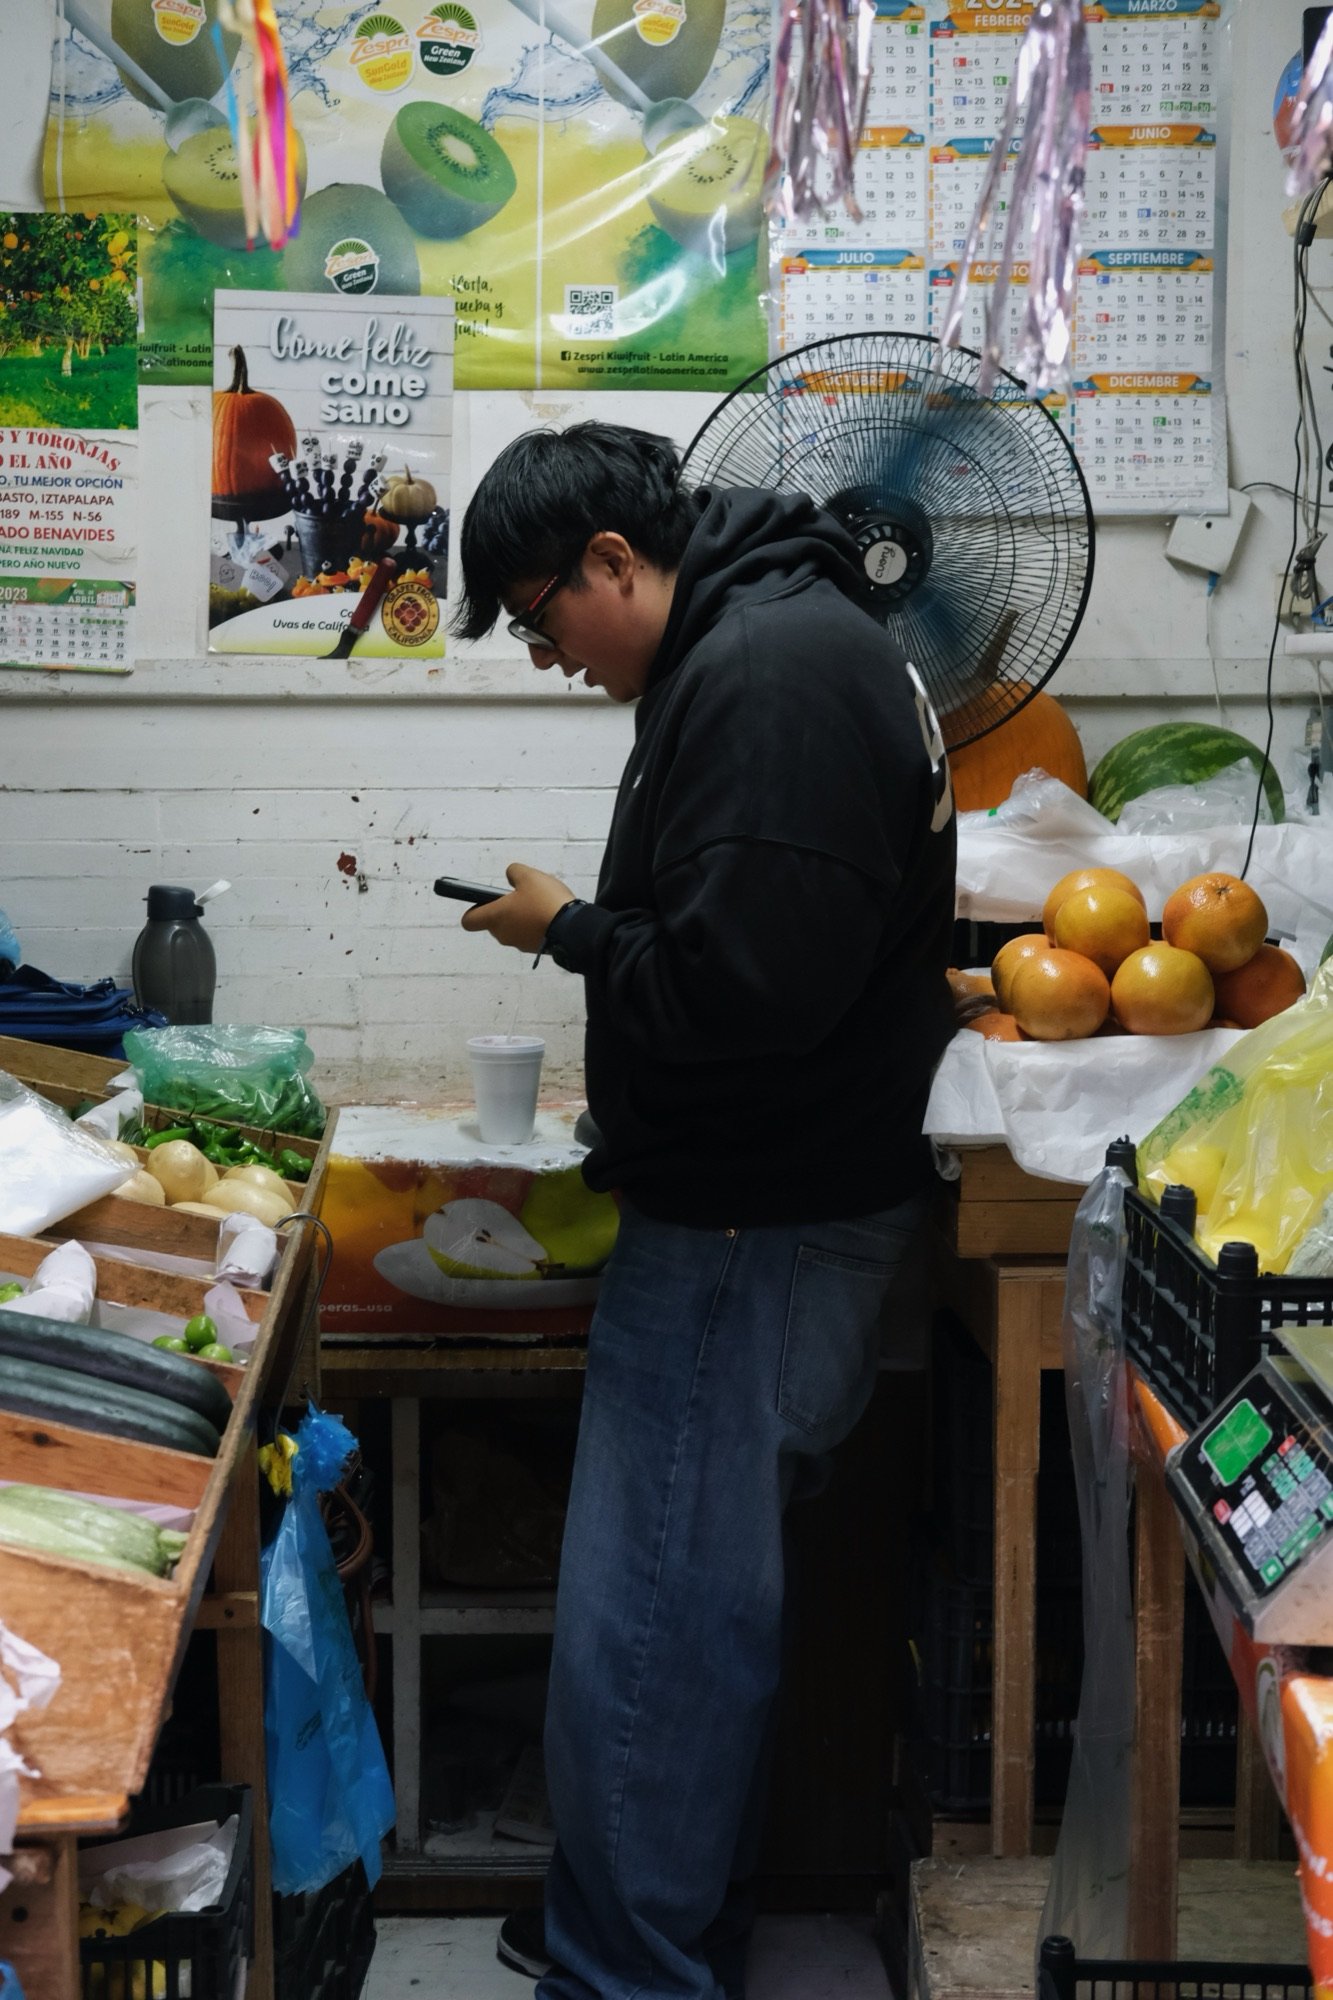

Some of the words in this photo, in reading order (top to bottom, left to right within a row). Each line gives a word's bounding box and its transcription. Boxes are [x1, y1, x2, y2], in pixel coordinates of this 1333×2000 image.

[1128, 0, 1178, 12] MARZO
[974, 15, 1032, 26] FEBRERO
[416, 16, 478, 43] Zespri
[349, 35, 409, 64] Zespri
[431, 45, 461, 57] Green
[886, 46, 894, 54] 12
[906, 46, 914, 54] 13
[424, 55, 439, 63] New
[440, 57, 466, 66] Zealand
[365, 60, 407, 78] SunGold
[906, 66, 916, 74] 20
[885, 86, 896, 94] 26
[906, 86, 916, 94] 27
[1129, 127, 1171, 140] JUNIO
[836, 252, 875, 264] JULIO
[1108, 252, 1184, 265] SEPTIEMBRE
[343, 270, 367, 283] Green
[974, 265, 1029, 276] AGOTO
[455, 299, 490, 312] rueba
[495, 302, 503, 318] y
[454, 318, 489, 341] fruta!
[138, 344, 176, 354] iwifruit
[186, 344, 211, 353] Latin
[270, 316, 352, 361] Come
[357, 317, 431, 371] feliz
[574, 352, 604, 363] Zespri
[607, 351, 650, 363] Kiwifruit
[659, 353, 685, 361] Latin
[688, 353, 729, 362] America
[578, 365, 728, 377] www.zesprilatinoamerica.com
[320, 371, 426, 398] come
[825, 374, 884, 386] OCTUBRE
[1109, 376, 1179, 388] DICIEMBRE
[320, 398, 410, 425] sano
[10, 431, 20, 443] Y
[26, 431, 121, 471] TORONJAS
[10, 454, 30, 468] EL
[35, 452, 72, 470] AÑO
[13, 475, 28, 486] TU
[32, 476, 71, 487] MEJOR
[75, 475, 123, 489] OPCIÓN
[41, 494, 114, 505] IZTAPALAPA
[29, 510, 64, 520] M-155
[73, 511, 102, 522] N-56
[34, 527, 115, 541] BENAVIDES
[15, 546, 39, 555] FELIZ
[41, 547, 84, 556] NAVIDAD
[23, 559, 45, 569] AÑO
[48, 561, 80, 570] NUEVO
[68, 596, 95, 604] ABRIL
[273, 619, 299, 630] Uvas
[302, 621, 315, 630] de
[318, 621, 369, 633] Califoa
